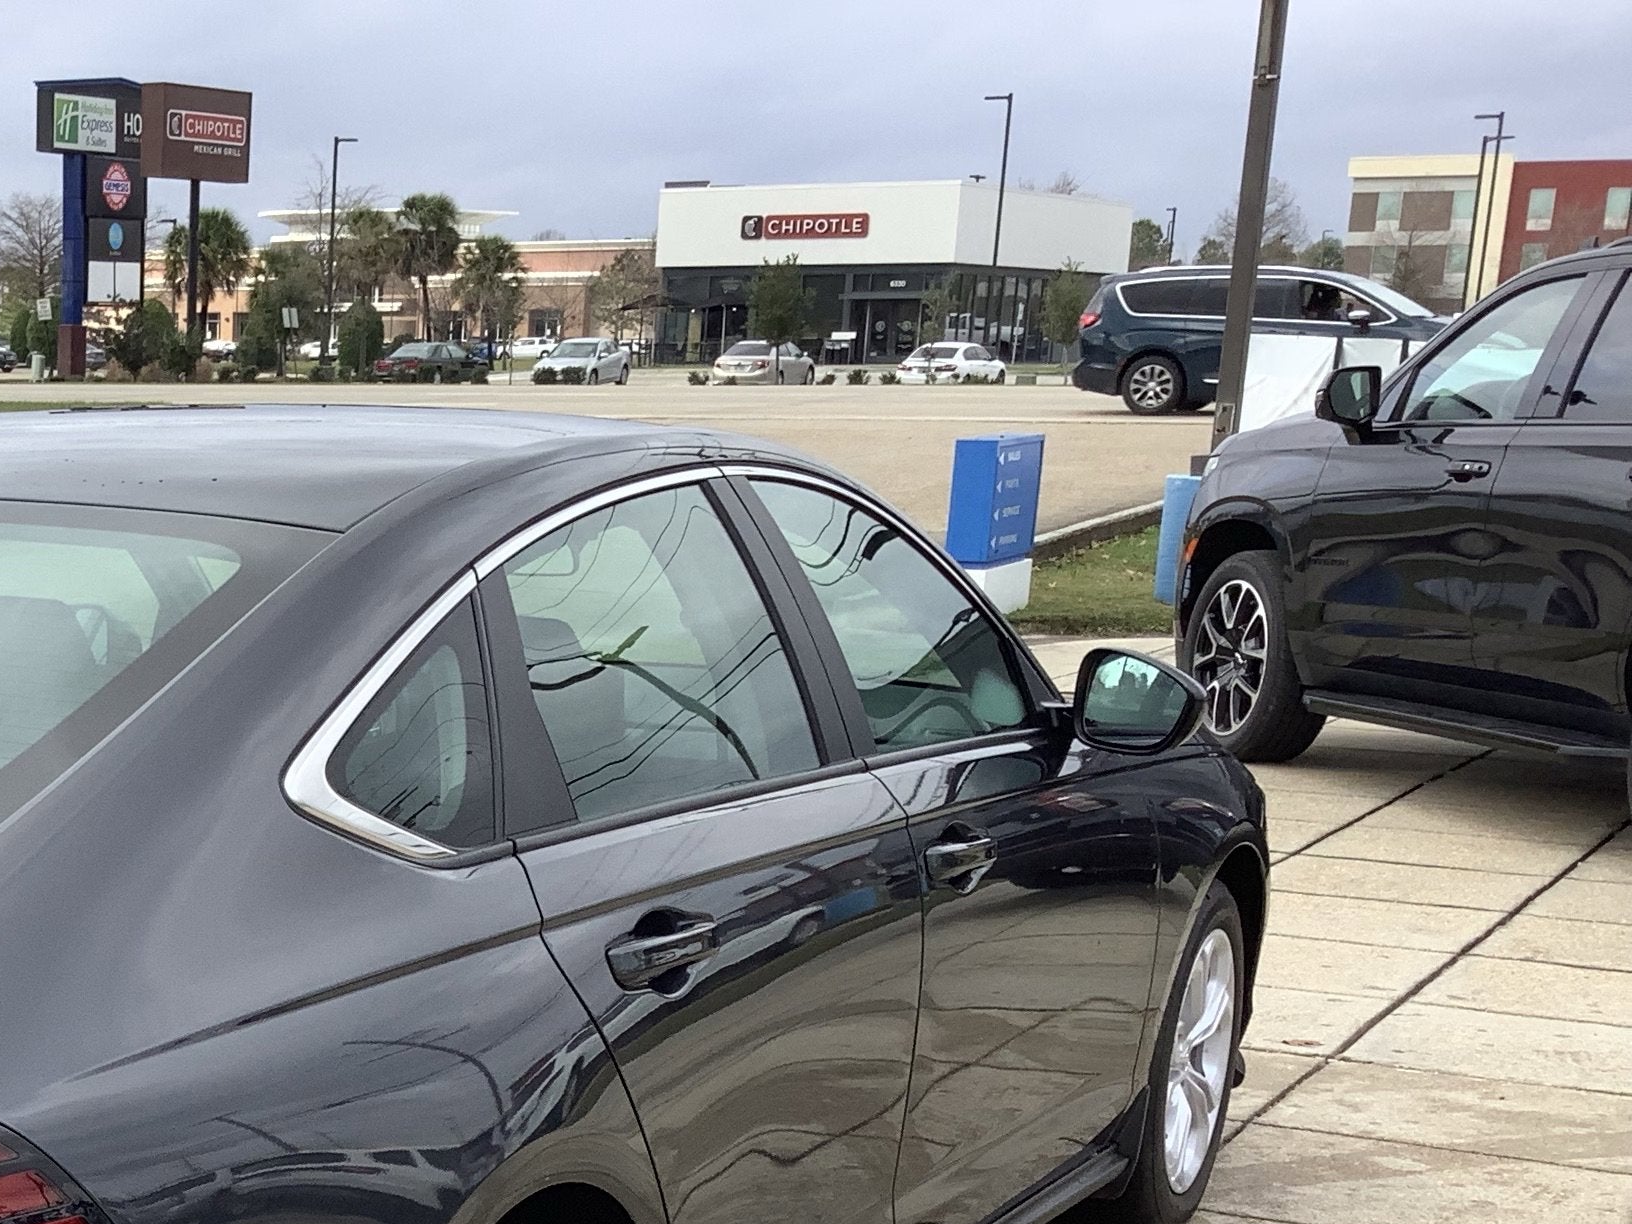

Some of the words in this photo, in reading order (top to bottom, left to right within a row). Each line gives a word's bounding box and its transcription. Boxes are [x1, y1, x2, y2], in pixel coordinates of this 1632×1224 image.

[81, 114, 113, 134] Express
[186, 118, 243, 139] CHIPOTLE
[193, 144, 223, 155] MEXICAN
[223, 147, 241, 157] GRILL
[768, 217, 863, 234] CHIPOTLE
